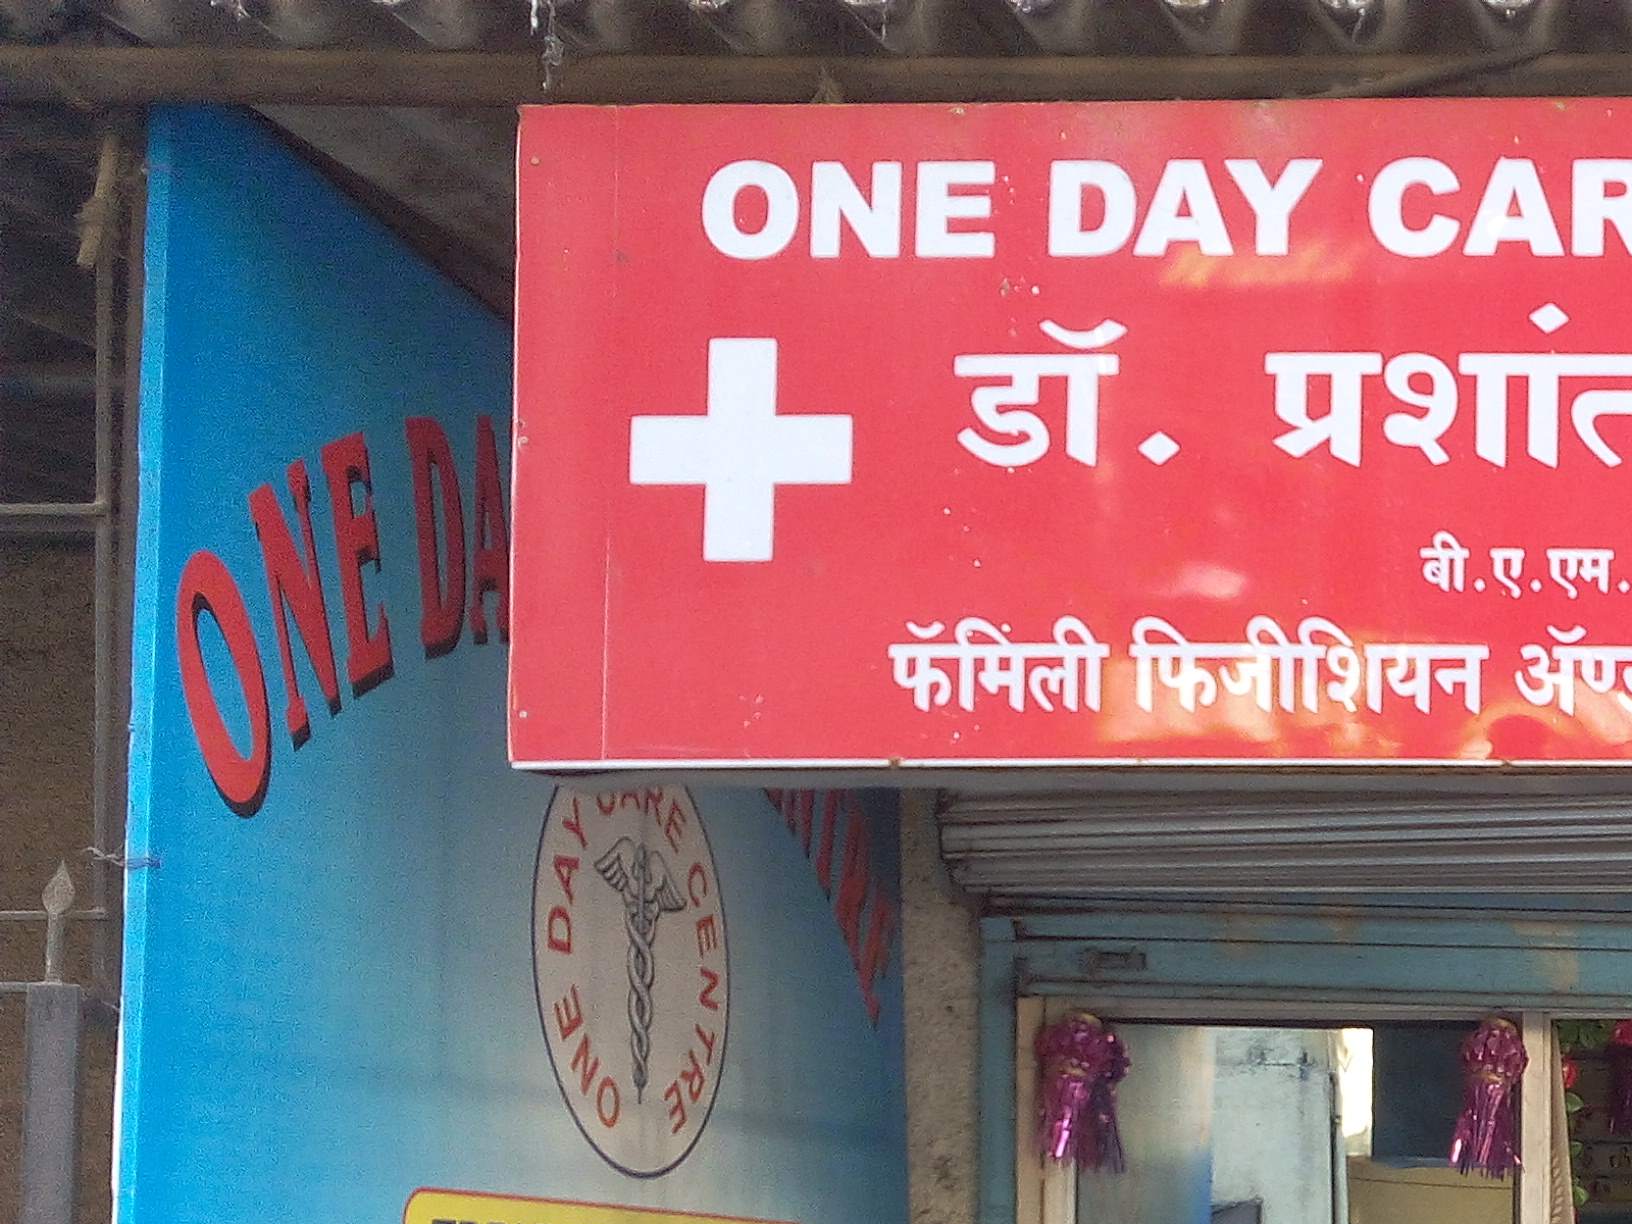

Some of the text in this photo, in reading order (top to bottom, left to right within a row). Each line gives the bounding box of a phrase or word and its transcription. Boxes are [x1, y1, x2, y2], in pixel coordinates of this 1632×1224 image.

[701, 158, 996, 261] ONE
[1048, 157, 1323, 258] DAY
[953, 318, 1181, 467] डॉ.
[176, 415, 511, 818] ONE DA
[1129, 615, 1489, 715] फिजीशियन
[547, 796, 588, 955] DAY
[554, 983, 620, 1129] ONE
[664, 862, 720, 1134] CENTRE
